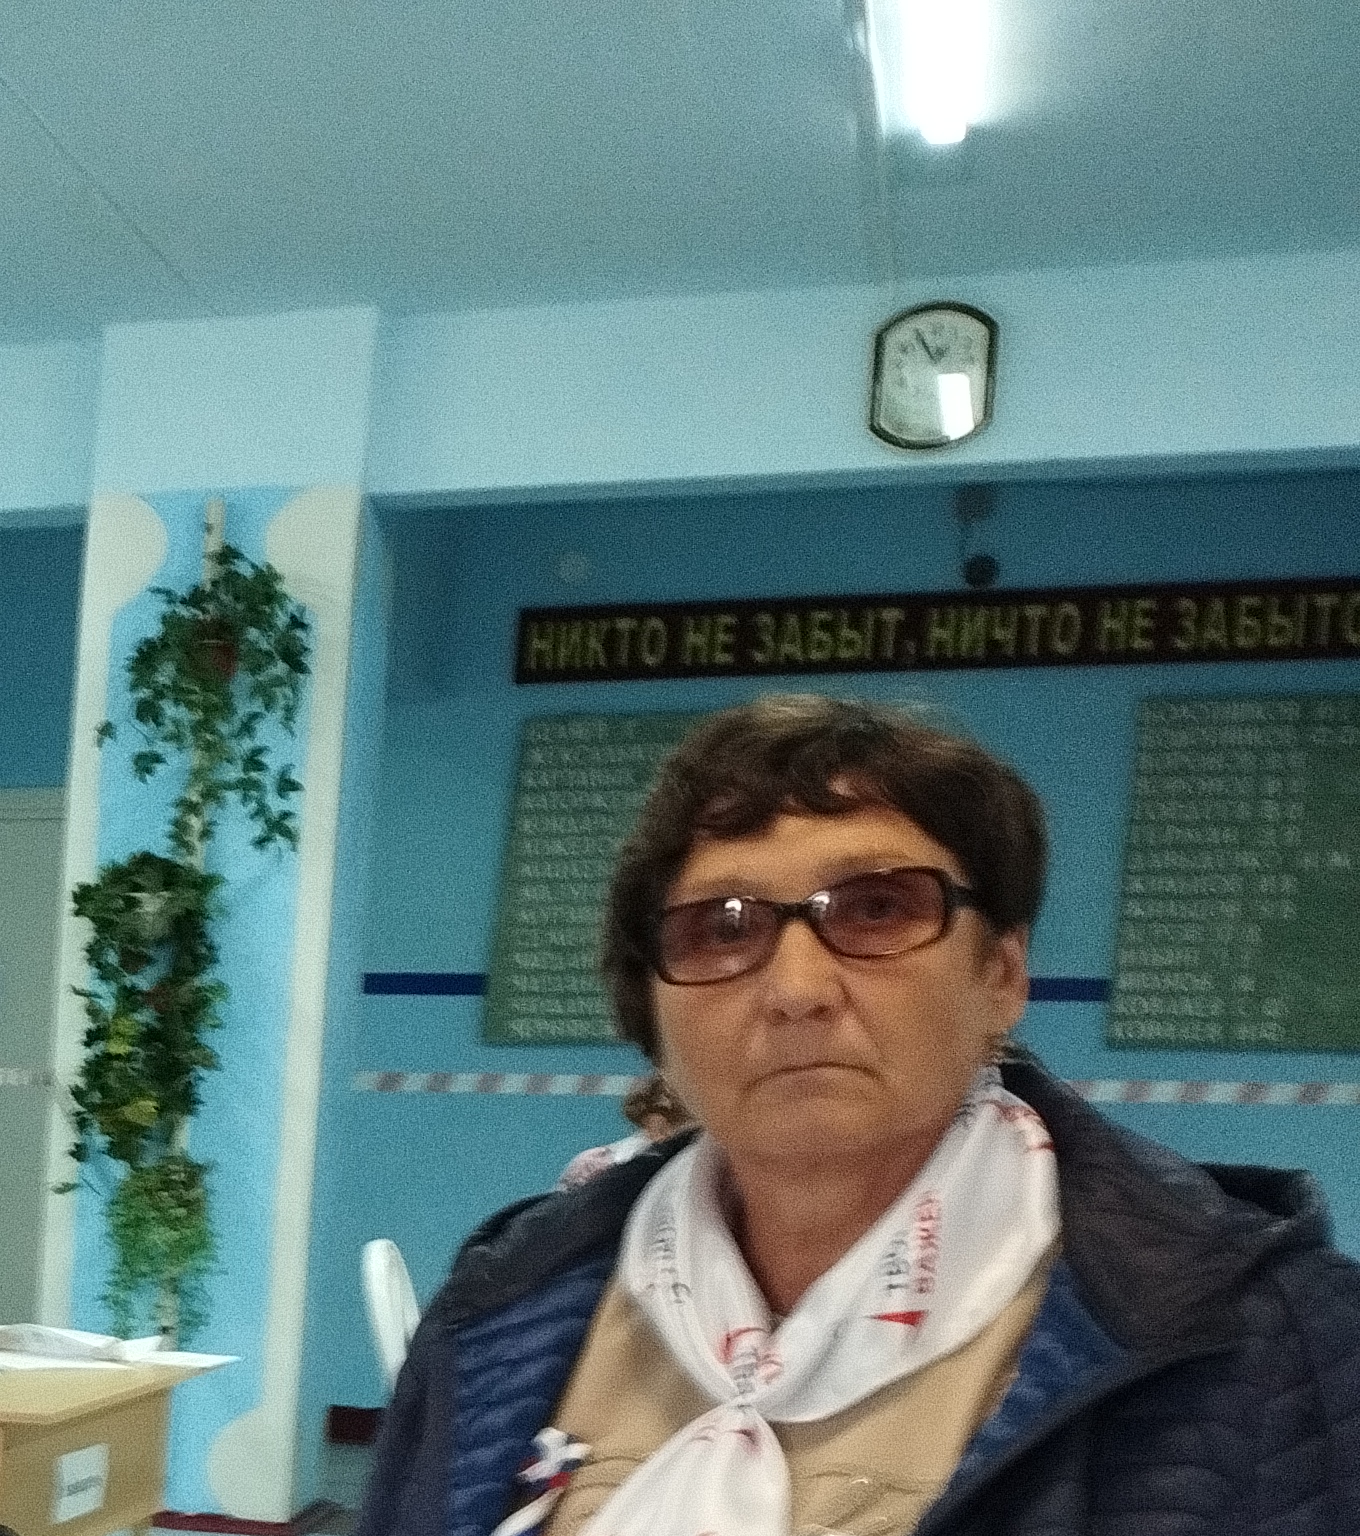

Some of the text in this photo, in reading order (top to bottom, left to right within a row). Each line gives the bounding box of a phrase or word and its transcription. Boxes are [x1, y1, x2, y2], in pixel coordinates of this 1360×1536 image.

[525, 616, 669, 670] НИКТО
[681, 612, 739, 667] НЕ
[926, 602, 1081, 660] НИЧТО
[1095, 597, 1159, 653] НЕ
